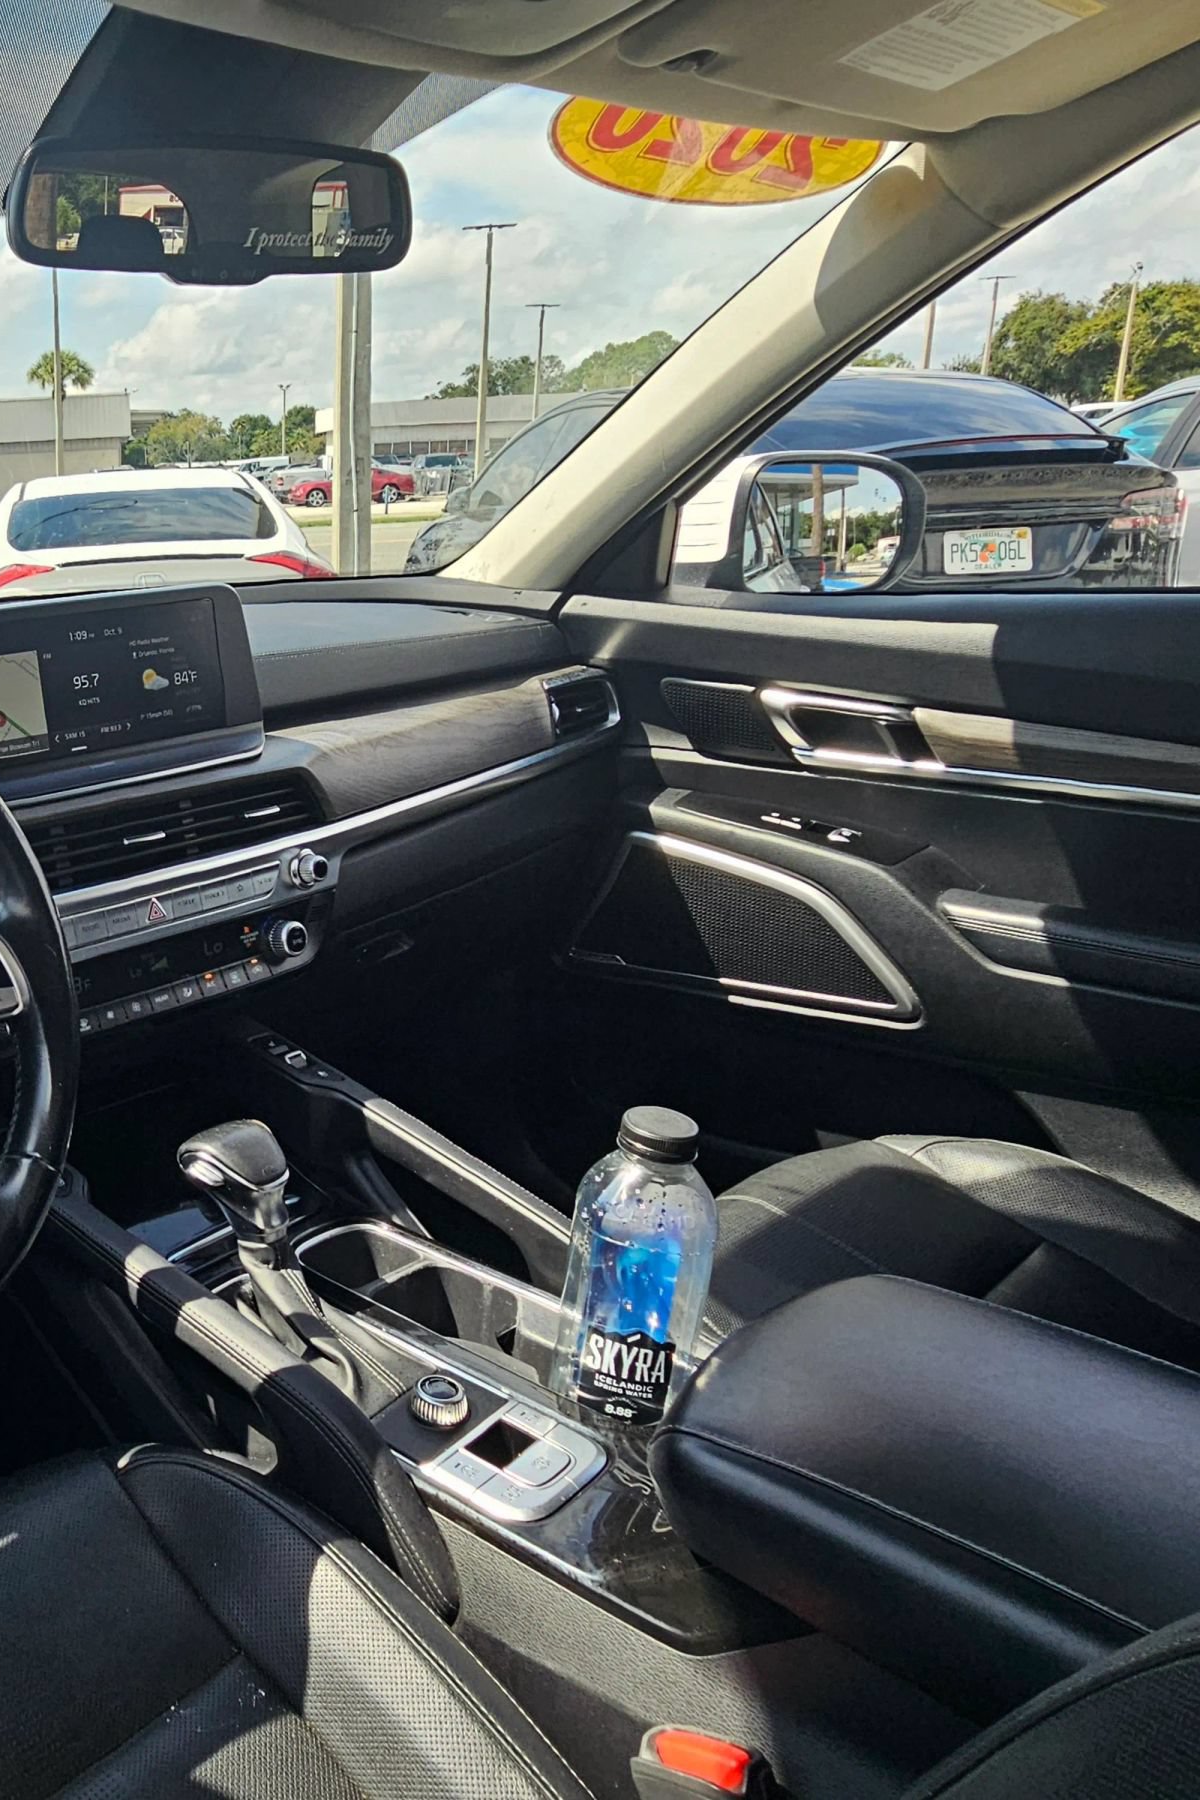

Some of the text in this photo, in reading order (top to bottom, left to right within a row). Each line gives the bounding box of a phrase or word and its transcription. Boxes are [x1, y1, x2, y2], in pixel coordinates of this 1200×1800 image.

[243, 227, 260, 247] I
[254, 231, 312, 255] protect
[335, 228, 394, 257] family
[69, 630, 88, 641] 1:09
[73, 673, 100, 690] 95.7
[593, 1380, 653, 1399] SPRING WATER
[595, 1373, 654, 1393] ICELANDIC
